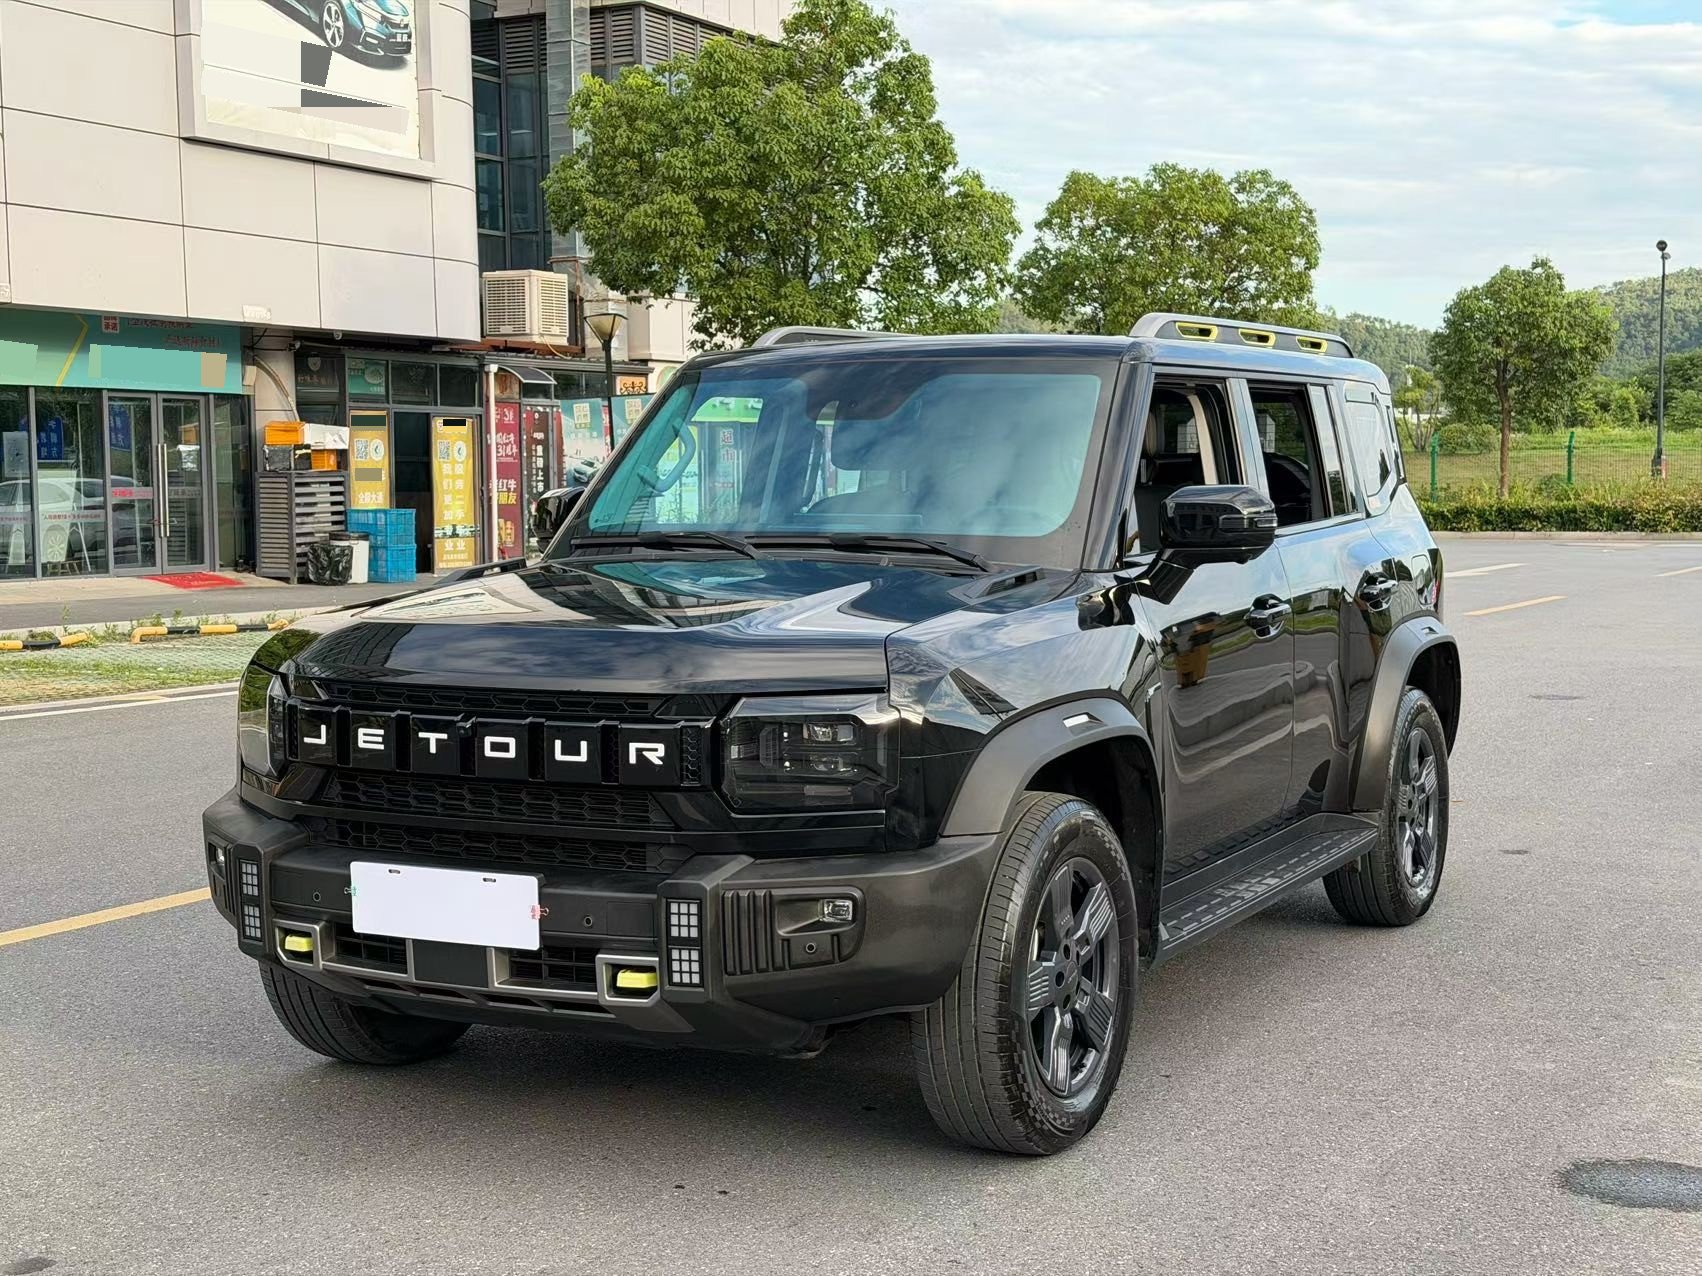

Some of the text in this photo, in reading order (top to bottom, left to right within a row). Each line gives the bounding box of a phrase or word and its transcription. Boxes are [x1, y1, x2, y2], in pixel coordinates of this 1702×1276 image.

[720, 428, 736, 462] 超市
[536, 444, 544, 493] 重磅上市
[442, 463, 454, 551] 我们更加业
[303, 724, 665, 765] JETOUR
